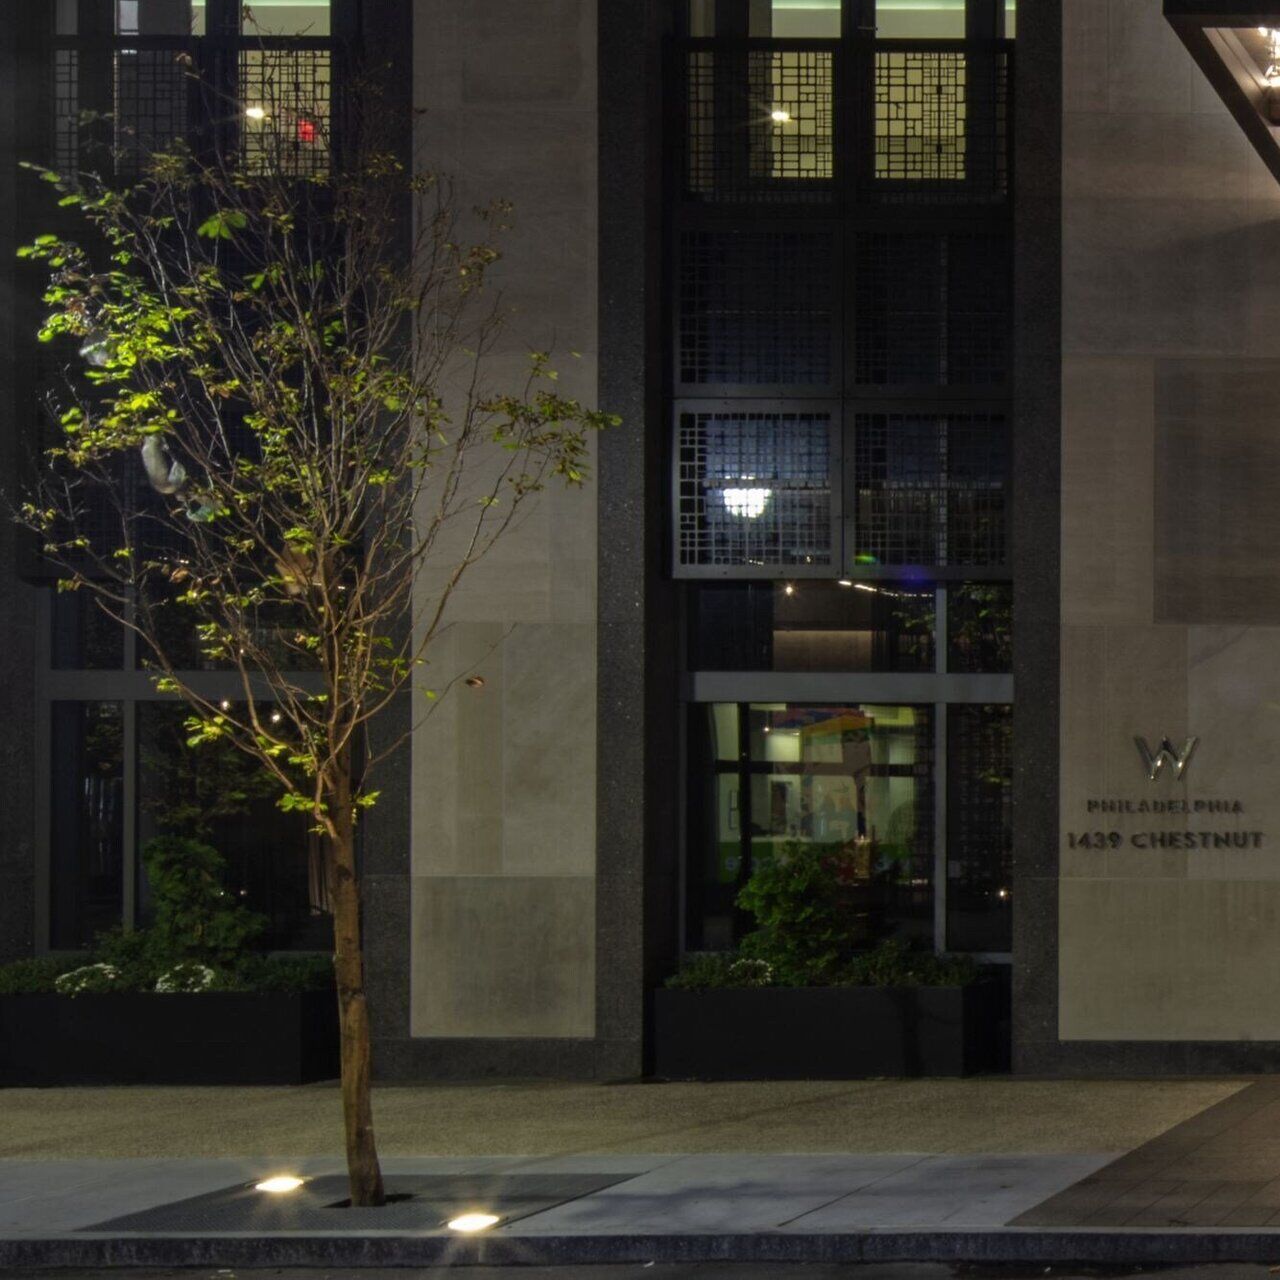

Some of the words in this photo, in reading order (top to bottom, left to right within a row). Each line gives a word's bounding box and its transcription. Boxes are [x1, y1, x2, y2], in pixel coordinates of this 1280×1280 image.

[1134, 735, 1199, 781] W
[1087, 799, 1243, 815] PHILADELPHIA
[1067, 831, 1122, 850] 1439
[1131, 831, 1265, 850] CHESTNUT
